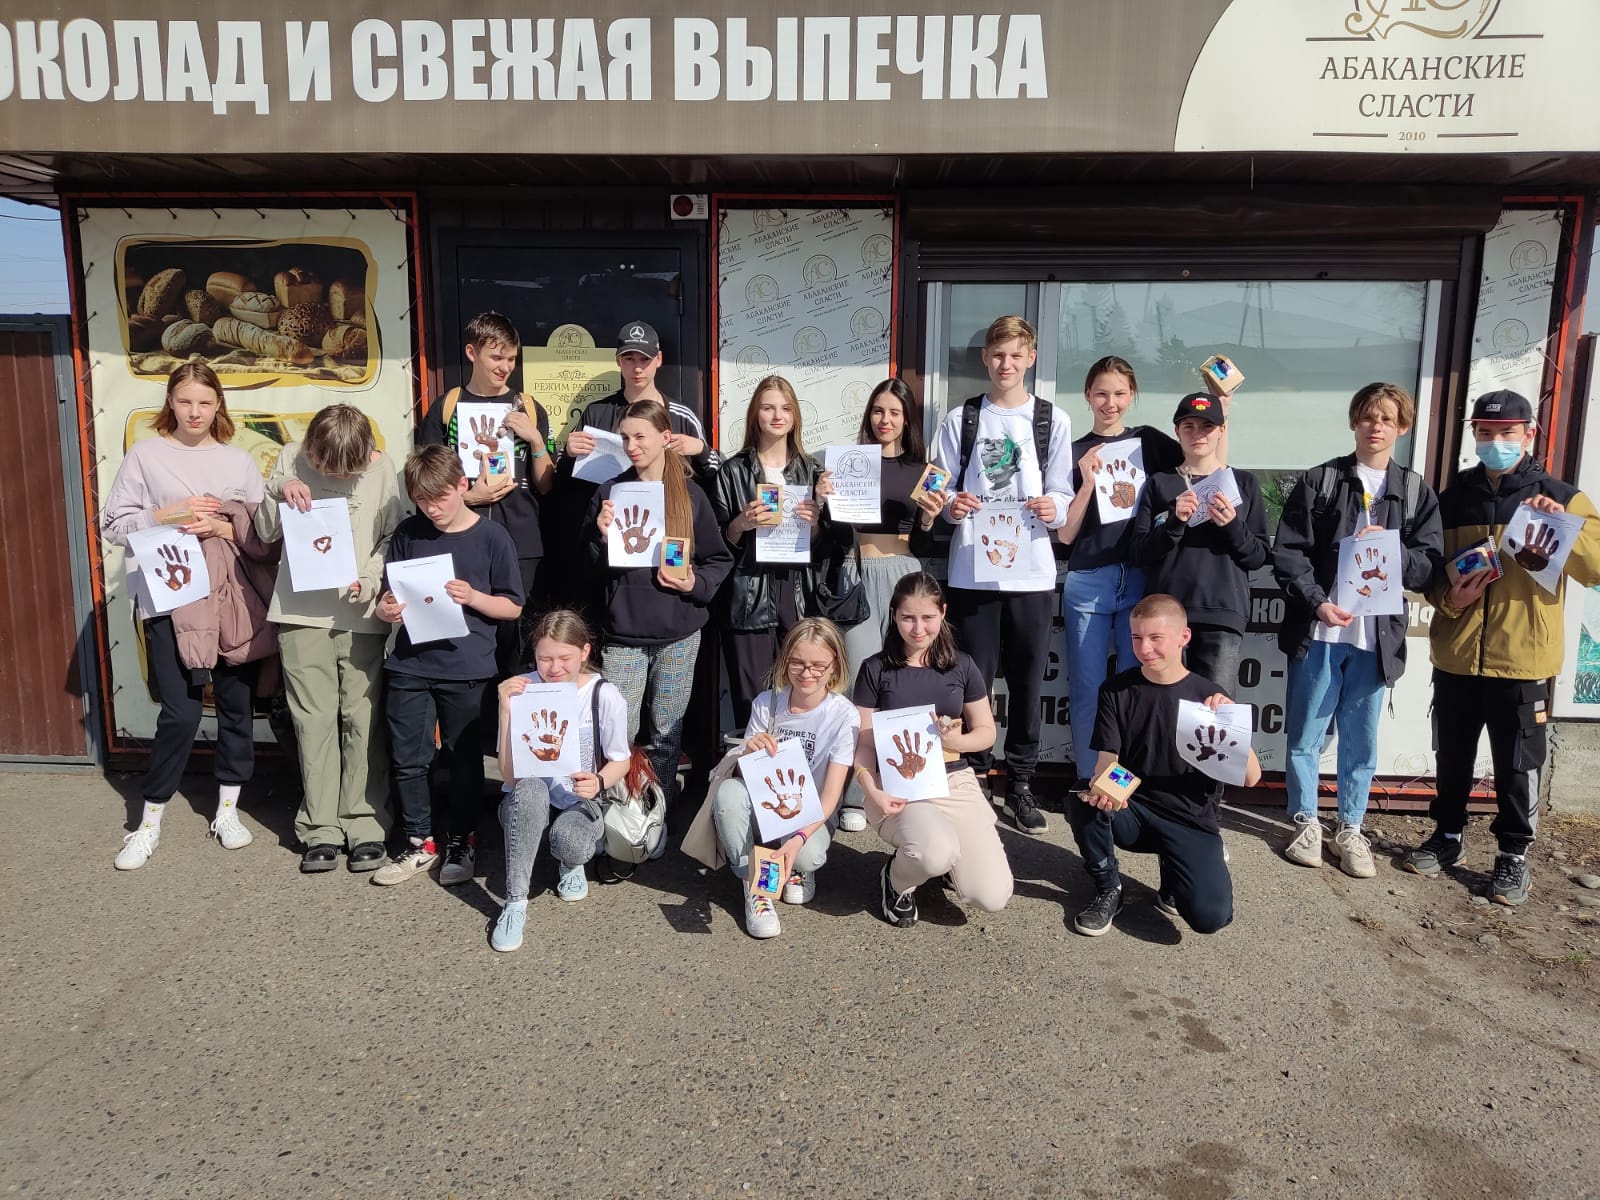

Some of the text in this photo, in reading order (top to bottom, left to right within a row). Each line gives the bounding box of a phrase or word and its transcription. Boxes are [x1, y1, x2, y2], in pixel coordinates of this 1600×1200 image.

[285, 20, 332, 102] И
[351, 18, 652, 102] СВЕЖАЯ
[673, 14, 1048, 101] ВЫПЕЧКА
[1319, 53, 1526, 81] АБАКАНСКИЕ
[1358, 93, 1475, 118] СЛАСТИ
[1398, 131, 1427, 142] 2010
[534, 382, 611, 392] РЕЖИМ РАБОТЫ
[778, 726, 817, 740] INSPIRE TO
